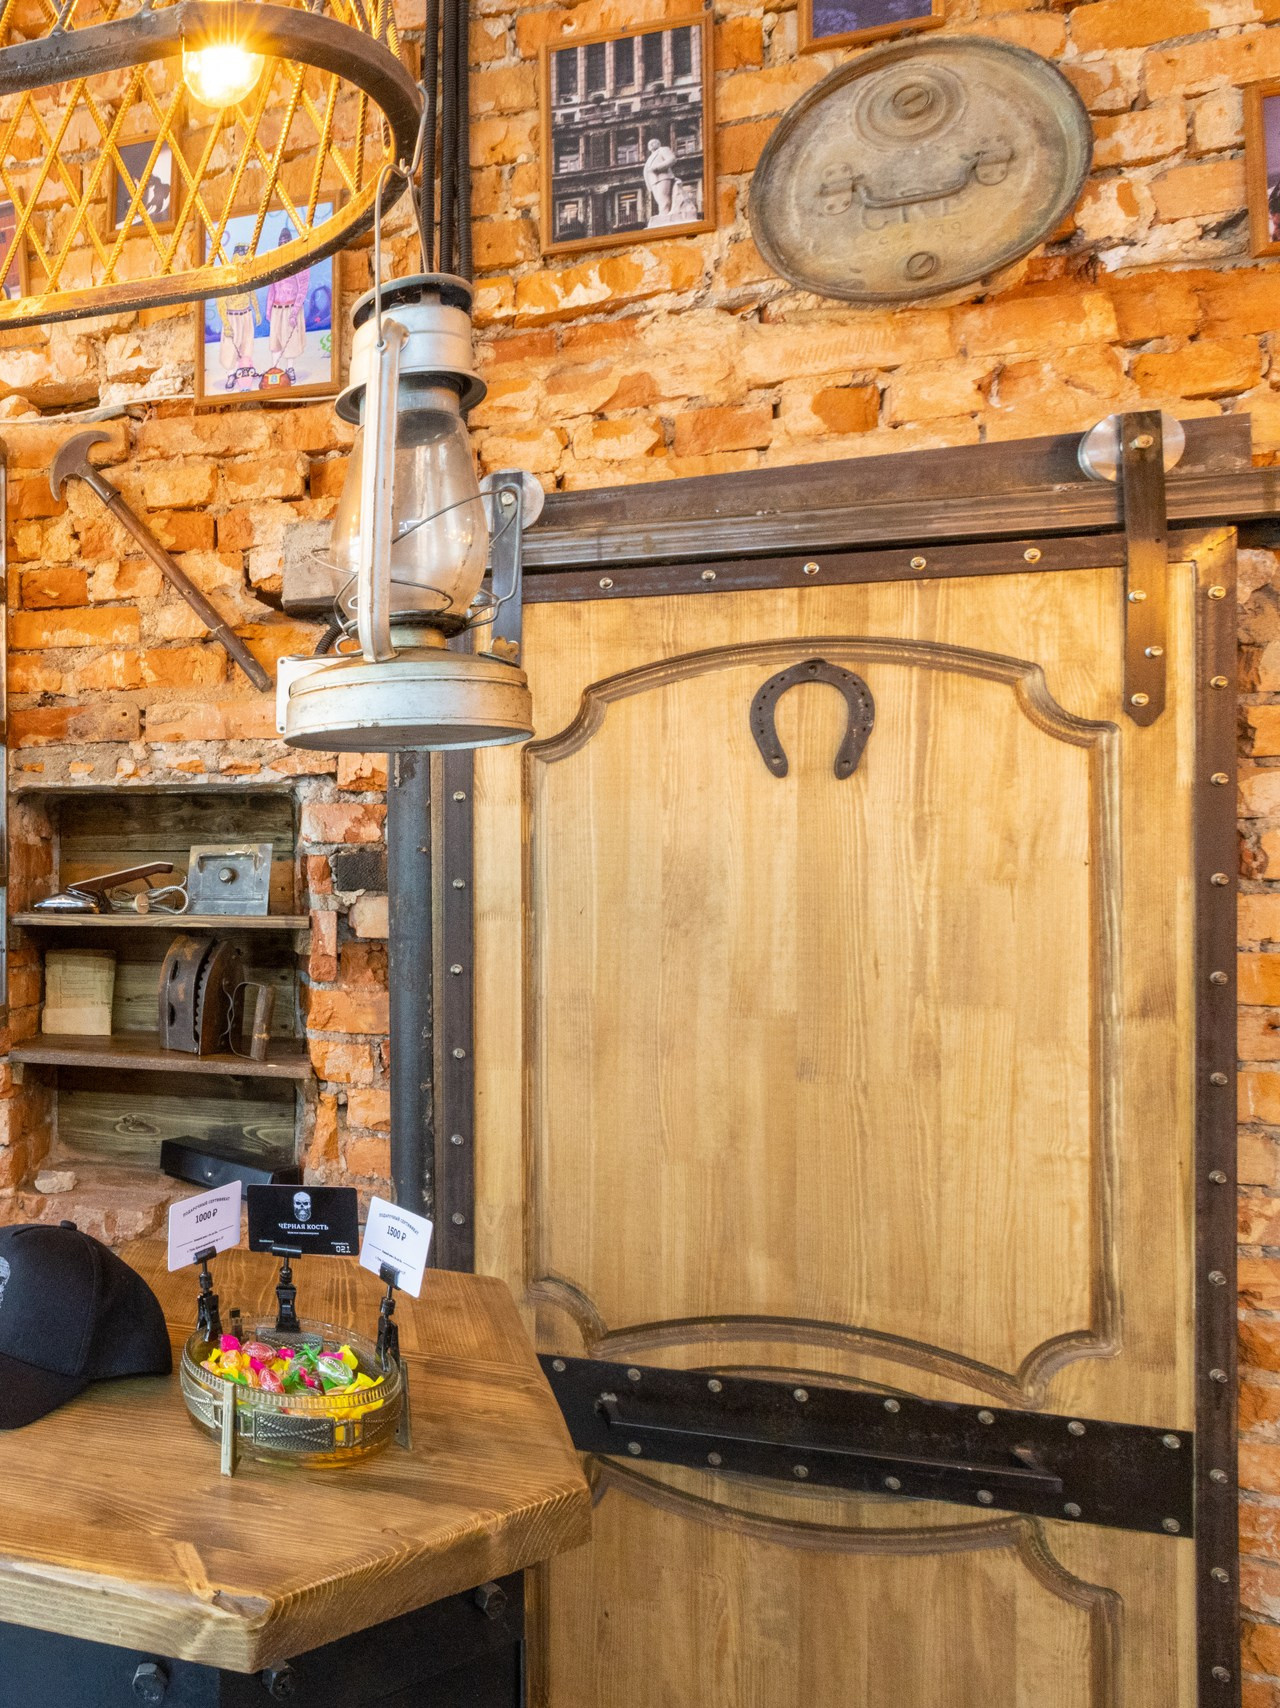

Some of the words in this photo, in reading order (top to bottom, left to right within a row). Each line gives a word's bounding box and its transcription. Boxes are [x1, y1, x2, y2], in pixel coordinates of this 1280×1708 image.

[195, 1211, 212, 1224] 1000
[278, 1222, 306, 1230] ЧЁРНАЯ
[306, 1223, 329, 1231] КОСТЬ
[386, 1225, 400, 1240] 1500
